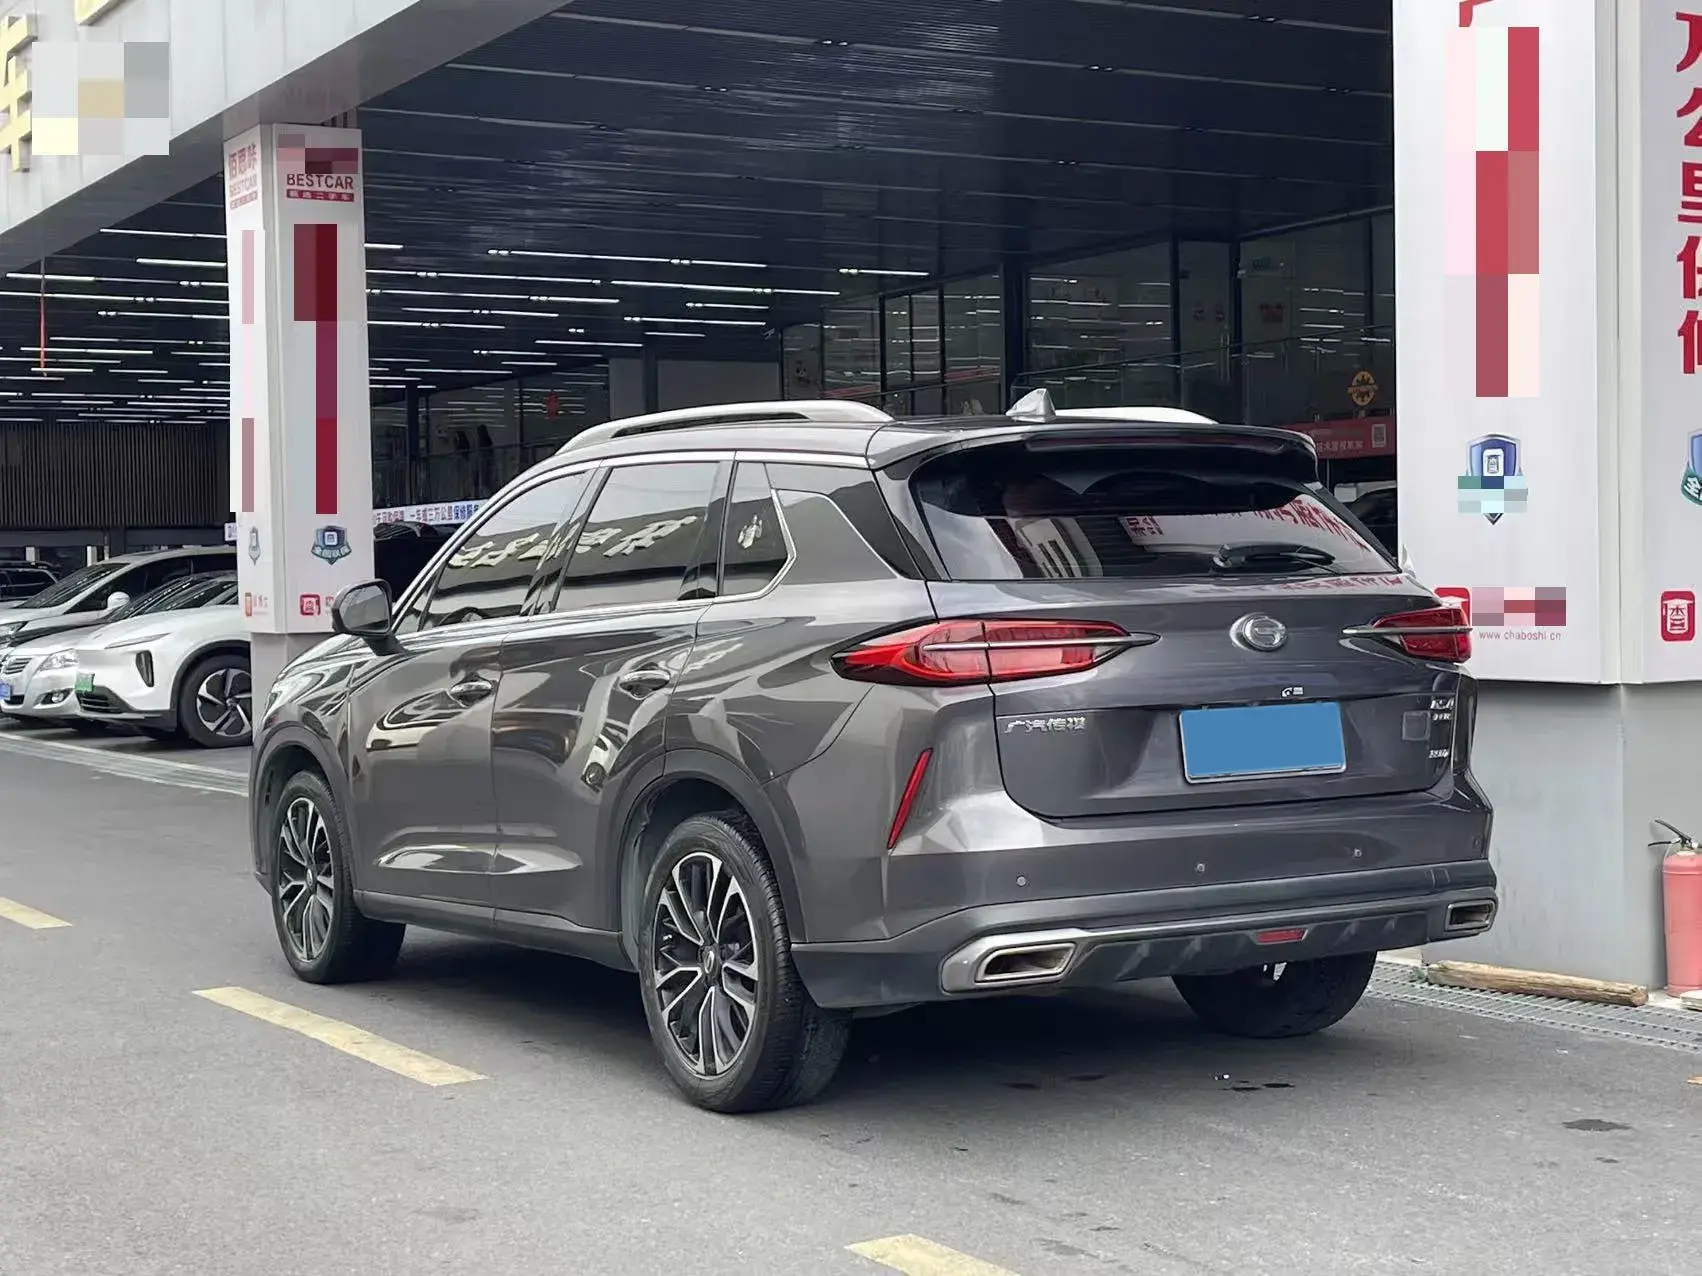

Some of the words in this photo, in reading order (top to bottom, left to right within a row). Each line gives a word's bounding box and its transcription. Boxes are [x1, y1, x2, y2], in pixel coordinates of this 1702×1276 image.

[287, 174, 353, 190] BESTCAR
[1004, 716, 1086, 734] 广汽传祺
